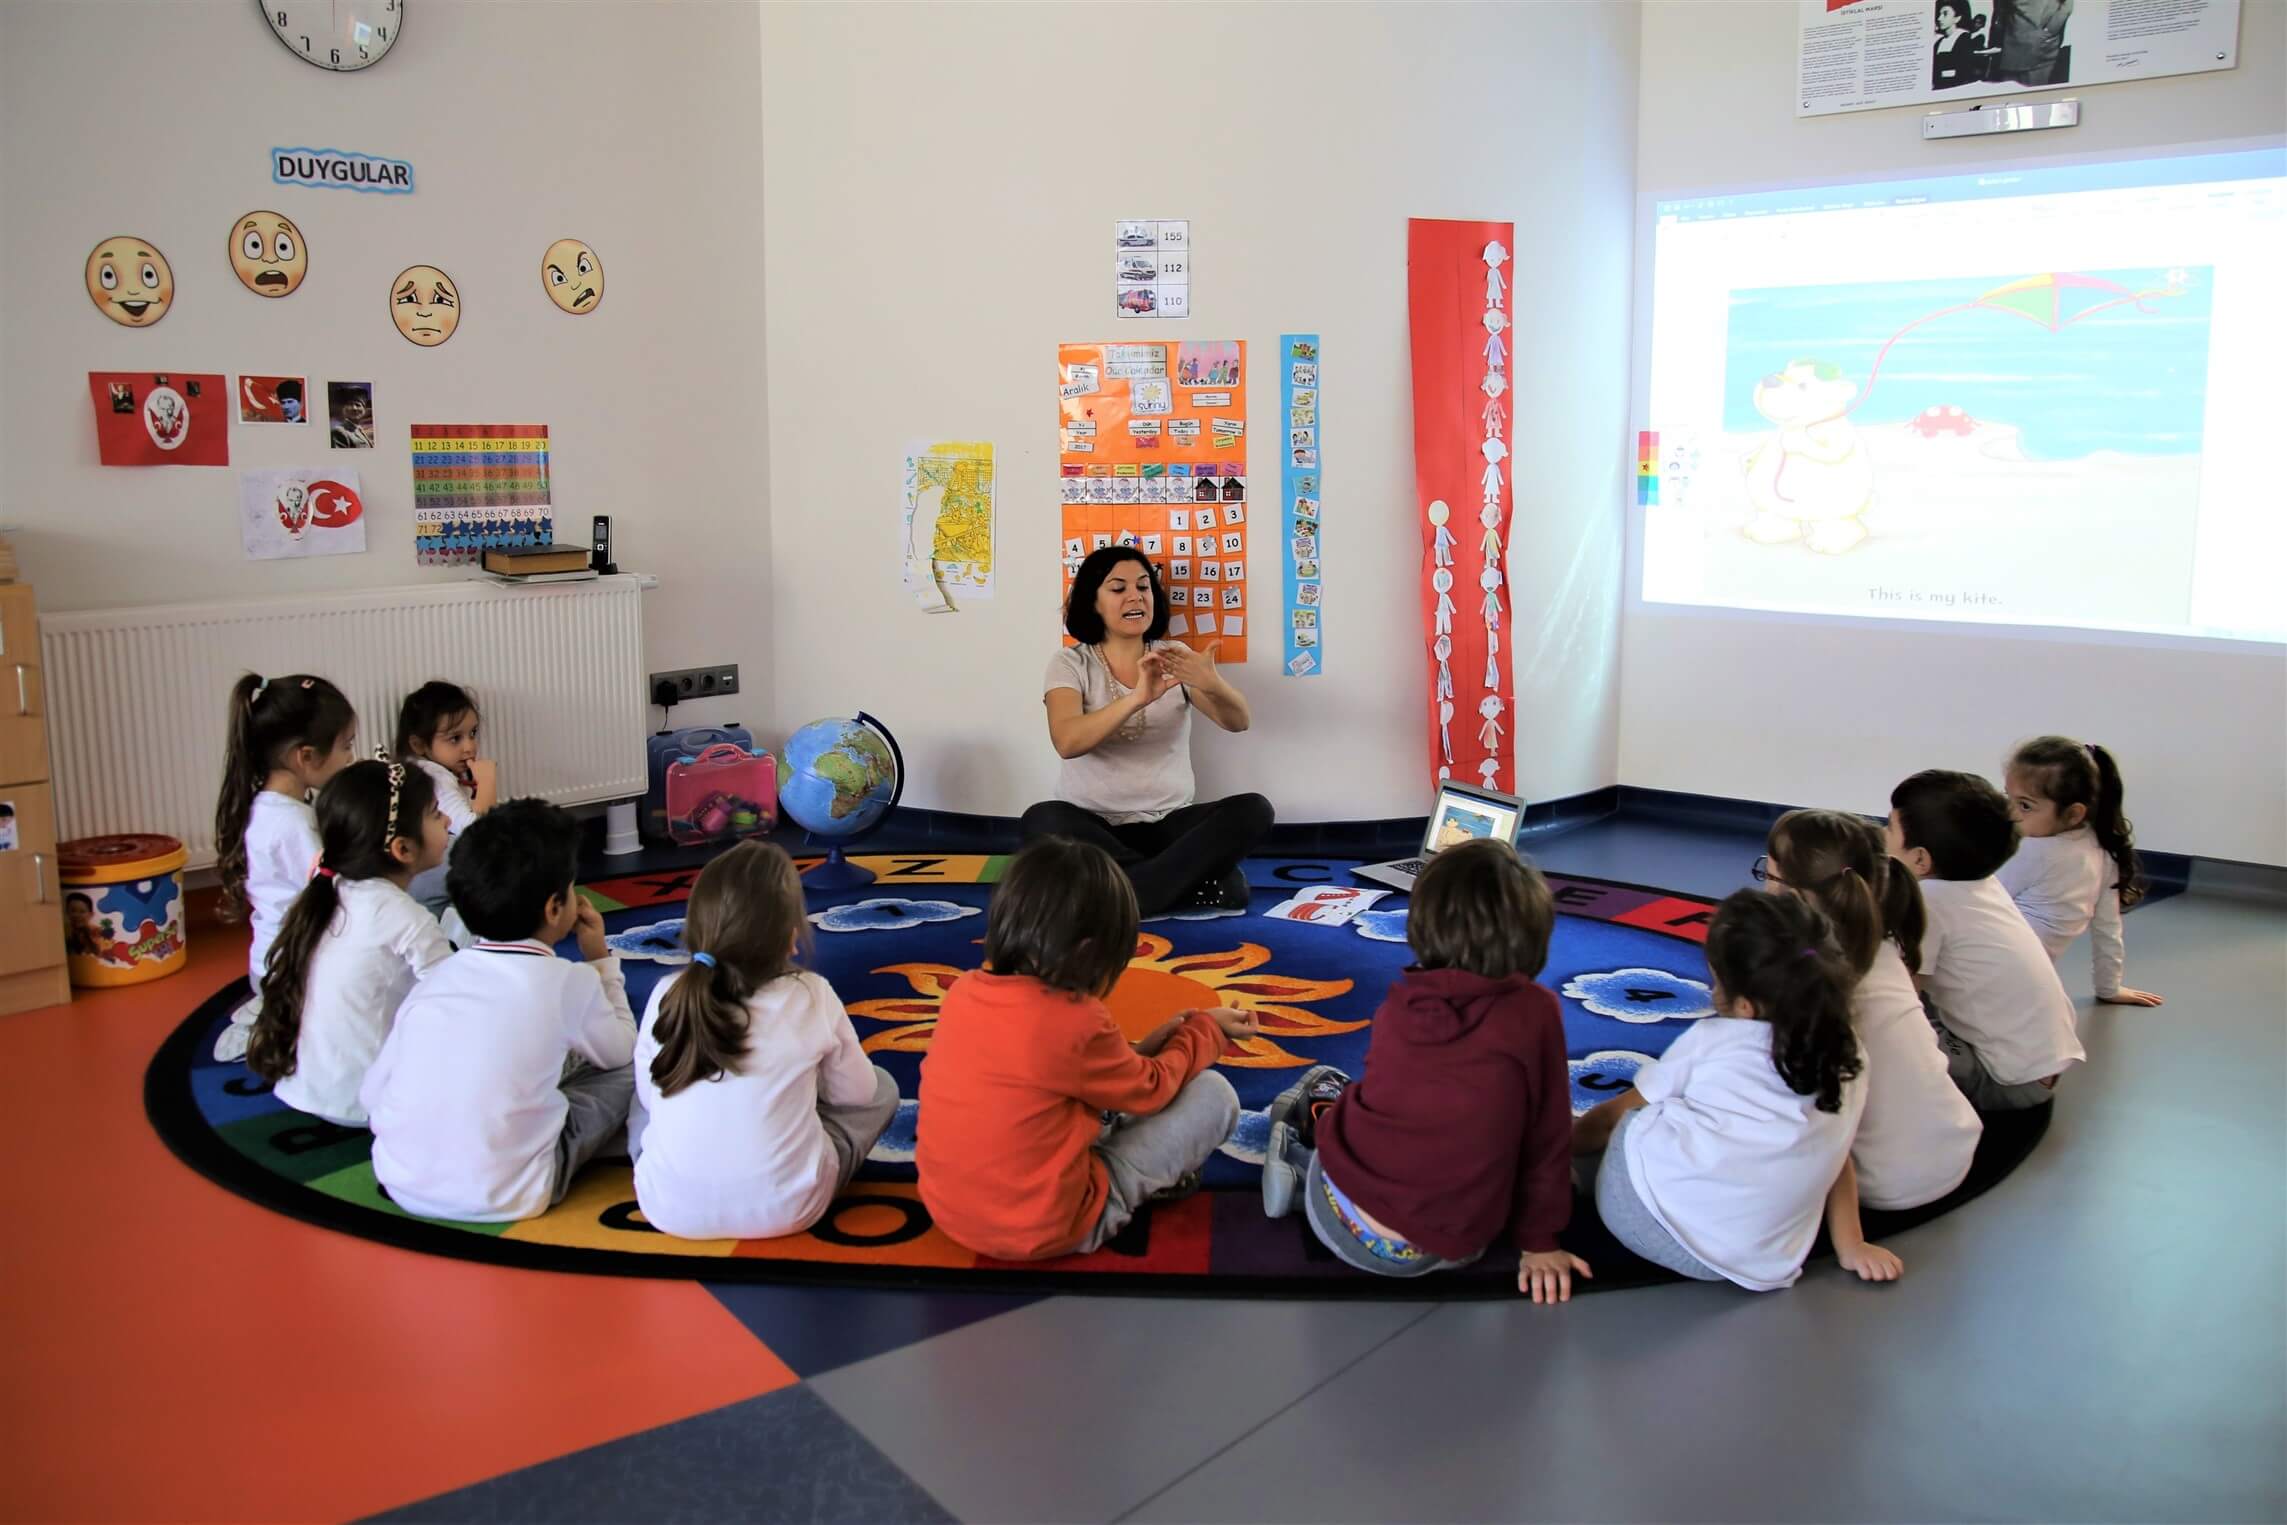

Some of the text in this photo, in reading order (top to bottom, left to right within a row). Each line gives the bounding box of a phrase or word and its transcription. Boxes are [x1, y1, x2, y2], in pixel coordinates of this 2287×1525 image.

[278, 11, 288, 27] 8
[377, 27, 386, 42] 4
[300, 36, 310, 52] 7
[330, 49, 340, 64] 6
[359, 45, 368, 60] 5
[278, 156, 409, 186] DUYGULAR
[1164, 232, 1182, 241] 155
[1164, 264, 1182, 272] 112
[1164, 297, 1182, 306] 110
[415, 442, 423, 450] 11
[428, 442, 437, 450] 12
[442, 442, 450, 450] 13
[455, 442, 464, 450] 14
[482, 442, 491, 450] 16
[496, 442, 504, 450] 17
[508, 442, 517, 450] 18
[522, 441, 530, 450] 19
[417, 484, 426, 492] 41
[429, 484, 440, 492] 42
[443, 484, 452, 492] 43
[418, 512, 427, 520] 61
[431, 512, 441, 520] 62
[458, 511, 468, 519] 64
[472, 510, 482, 518] 65
[485, 510, 495, 518] 66
[511, 509, 521, 517] 68
[524, 508, 534, 516] 69
[538, 508, 548, 516] 70
[1178, 510, 1237, 526] 1 2 3
[1072, 544, 1078, 552] 4
[1100, 540, 1106, 549] 5
[1148, 541, 1155, 550] 7
[1180, 542, 1186, 551] 8
[1226, 538, 1239, 548] 10
[1175, 566, 1187, 575] 15
[1205, 567, 1216, 576] 16
[1229, 566, 1240, 576] 17
[1172, 592, 1238, 604] 22 23 24
[1869, 586, 1902, 601] This
[1910, 591, 1922, 601] is
[1930, 593, 1955, 606] my
[886, 859, 947, 875] Z
[1272, 864, 1333, 882] C
[632, 875, 693, 896] X
[1553, 887, 1608, 906] E
[1623, 988, 1678, 1003] 4
